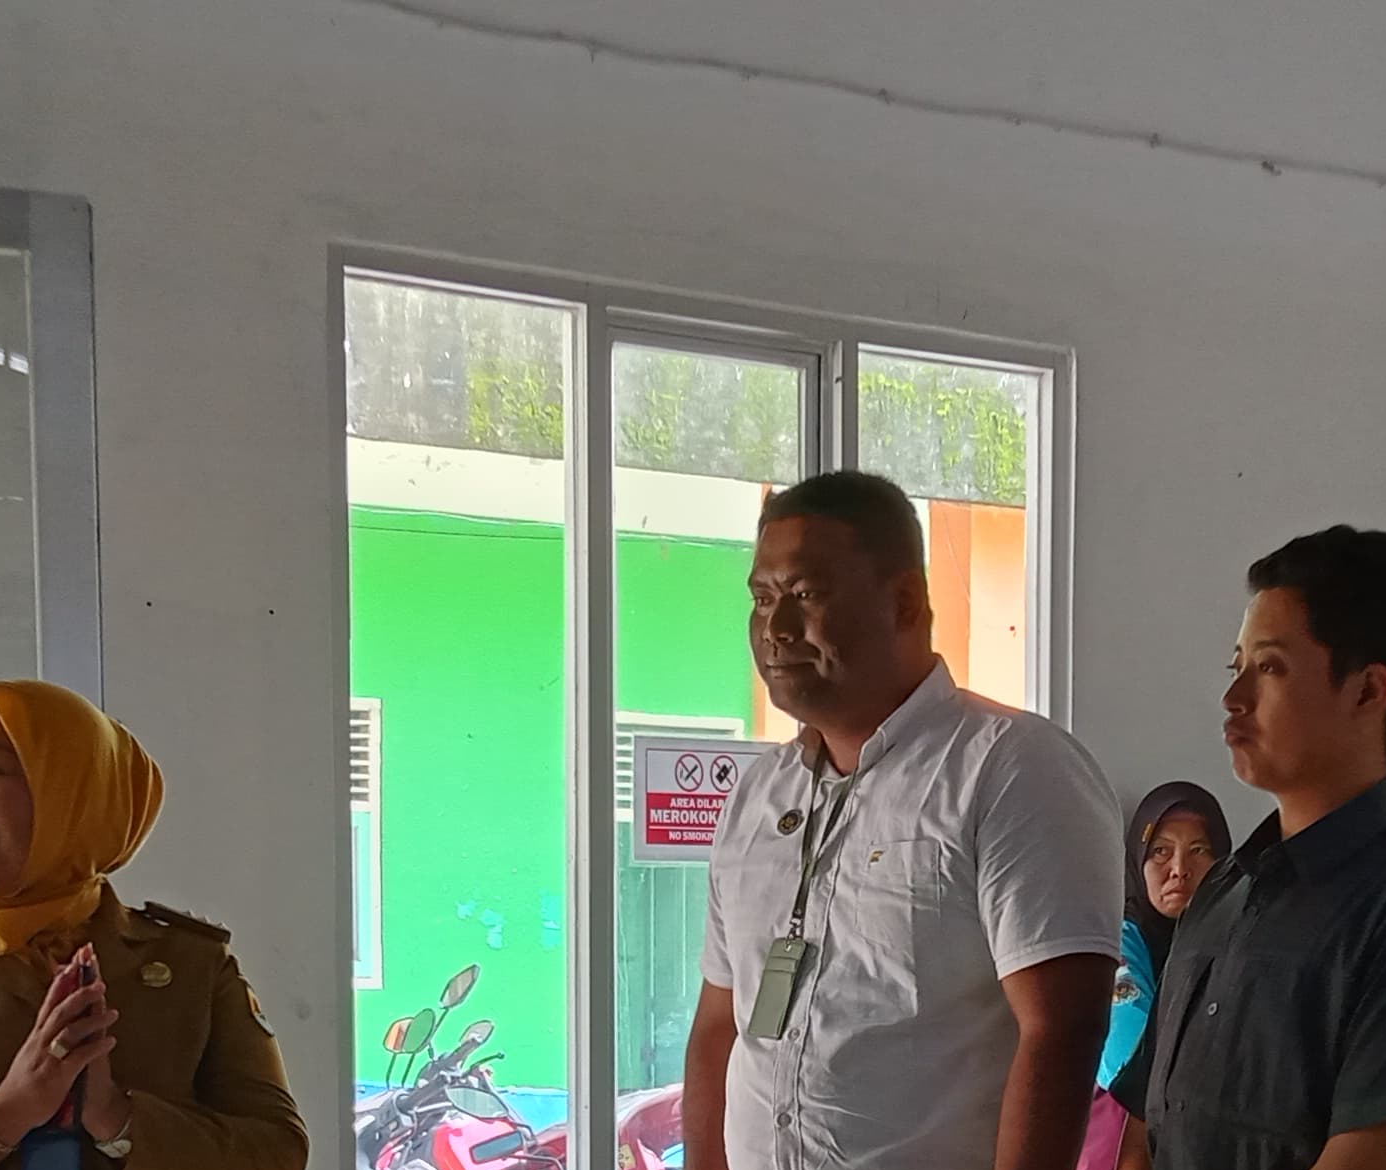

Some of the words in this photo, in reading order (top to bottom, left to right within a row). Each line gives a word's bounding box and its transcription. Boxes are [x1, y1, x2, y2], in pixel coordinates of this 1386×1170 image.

[670, 798, 695, 808] AREA
[650, 809, 717, 824] MEROKOK
[669, 831, 681, 841] NO
